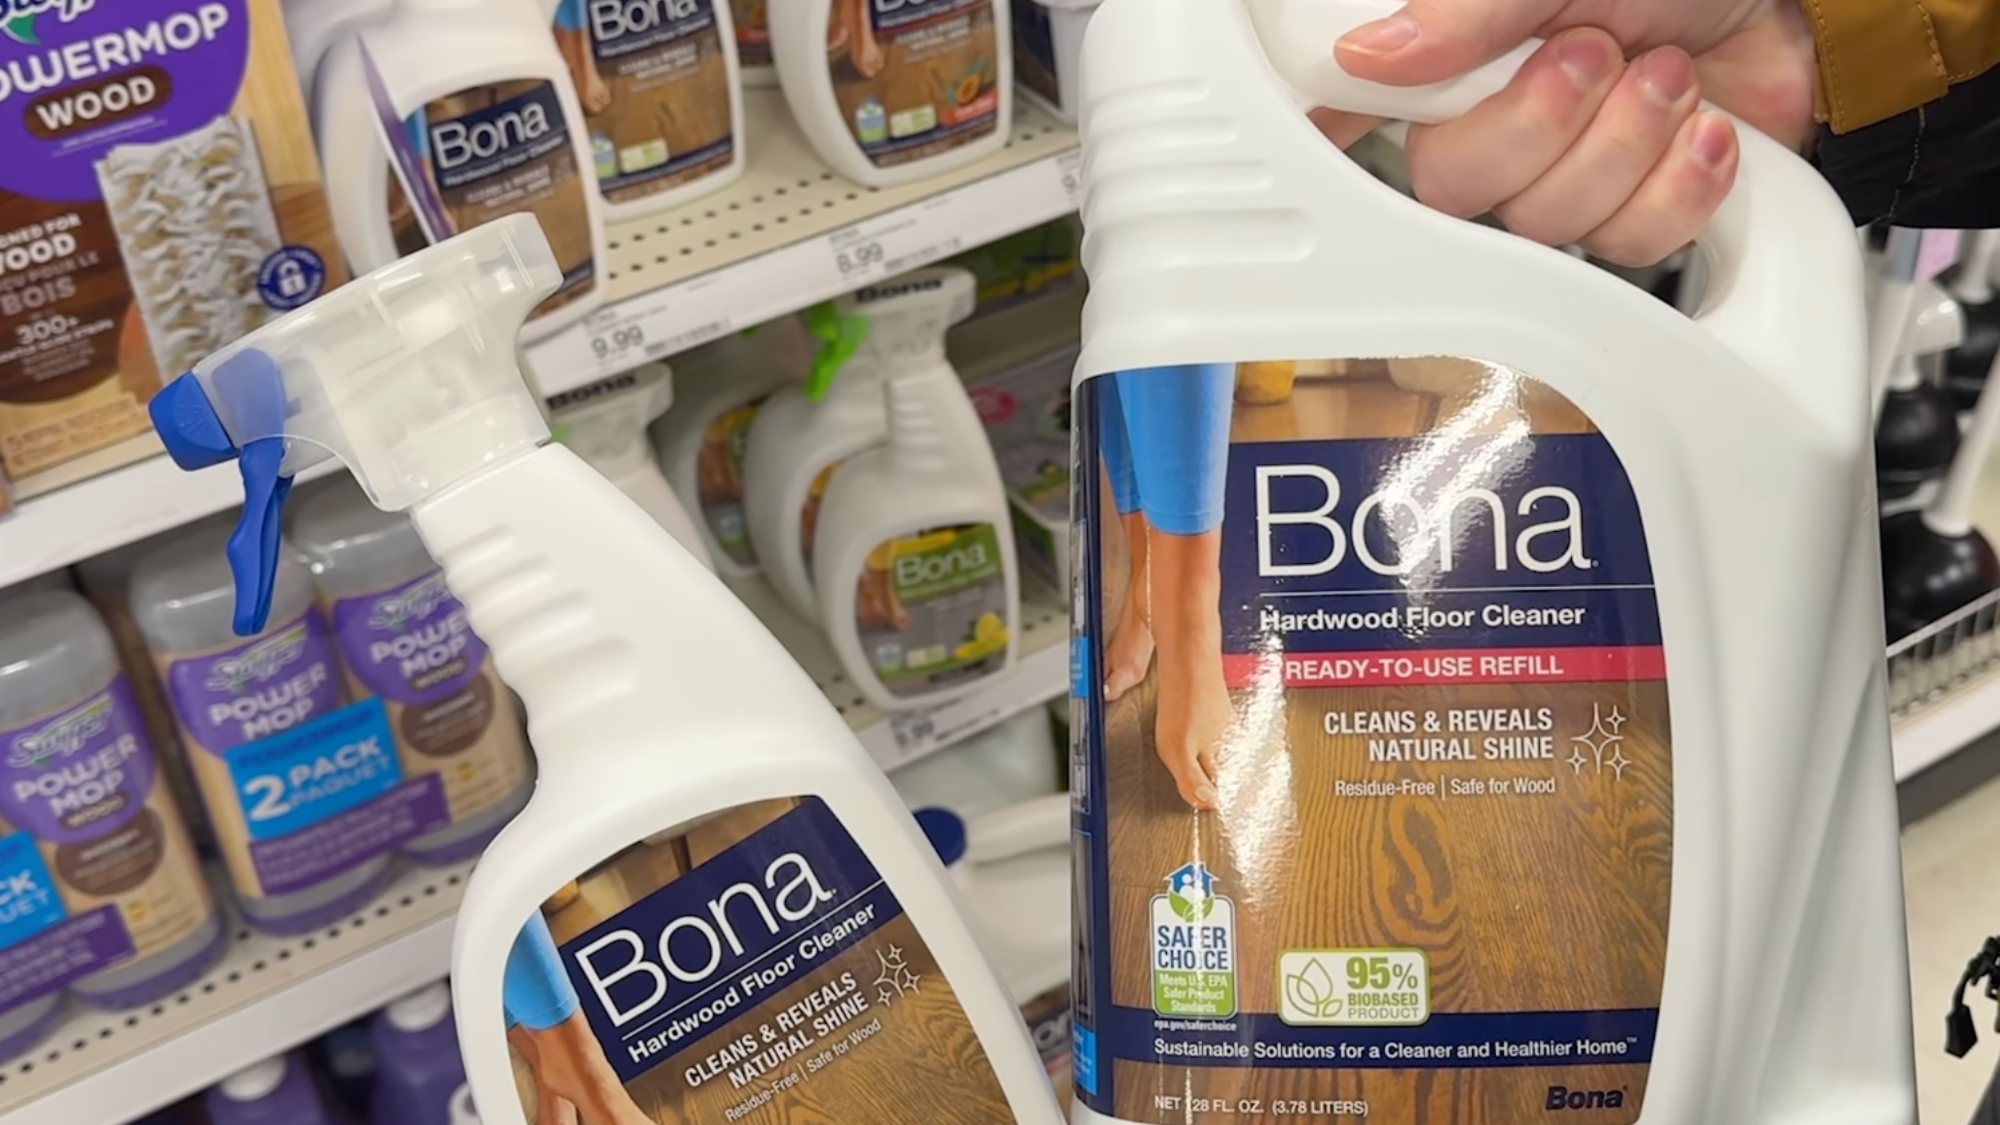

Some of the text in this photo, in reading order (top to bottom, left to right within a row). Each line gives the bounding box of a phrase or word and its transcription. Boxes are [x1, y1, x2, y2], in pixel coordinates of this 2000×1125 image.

[36, 76, 156, 131] WOOD
[432, 102, 551, 170] Bona
[0, 232, 77, 275] OOD
[1, 275, 77, 317] BOIS
[14, 313, 80, 346] 300+
[591, 324, 644, 359] 9.99
[1255, 463, 1600, 577] Bona
[896, 543, 988, 588] Bona
[370, 607, 469, 665] POWE
[1260, 603, 1586, 633] Hardwood Floor Cleaner
[401, 635, 468, 679] MOP
[1285, 655, 1564, 680] READY-TO-USE REFILL
[208, 661, 328, 727] POWER
[242, 696, 315, 741] MOP
[1324, 707, 1553, 735] CLEANS & REVEALS
[13, 732, 139, 803] POWER
[1368, 736, 1555, 763] NATURAL SHINE
[50, 768, 125, 818] MOP
[244, 774, 293, 822] 2
[288, 735, 382, 789] PACK
[289, 754, 391, 808] PAQUET
[1335, 775, 1556, 798] Residue-Free Safe for Wood
[574, 852, 836, 1027] Bona
[1157, 925, 1227, 949] SAFER
[626, 903, 876, 1064] Hardwood Floor Cleaner
[1159, 974, 1187, 987] Meets
[1208, 974, 1229, 987] EPA
[1162, 986, 1187, 999] Safer
[1345, 956, 1419, 990] 95%
[1347, 992, 1419, 1007] BIOBASED
[1348, 1006, 1419, 1020] PRODUCT
[684, 971, 858, 1089] CLEANS & REVEALS
[727, 991, 870, 1090] NATURAL SHINE
[1153, 1018, 1237, 1032] epa.gov/saferchoice
[1154, 1039, 1249, 1058] Sustainable
[1253, 1042, 1336, 1059] Solutions
[1339, 1042, 1366, 1059] for
[1369, 1046, 1380, 1059] a
[1384, 1042, 1453, 1059] Cleaner
[1457, 1041, 1490, 1058] and
[1495, 1039, 1572, 1057] Healthier
[724, 1018, 882, 1123] Residue-Free Safe for Wood
[1154, 1096, 1369, 1116] NET 28 FL. OZ. (3.78 LITERS)
[1545, 1086, 1625, 1111] Bona
